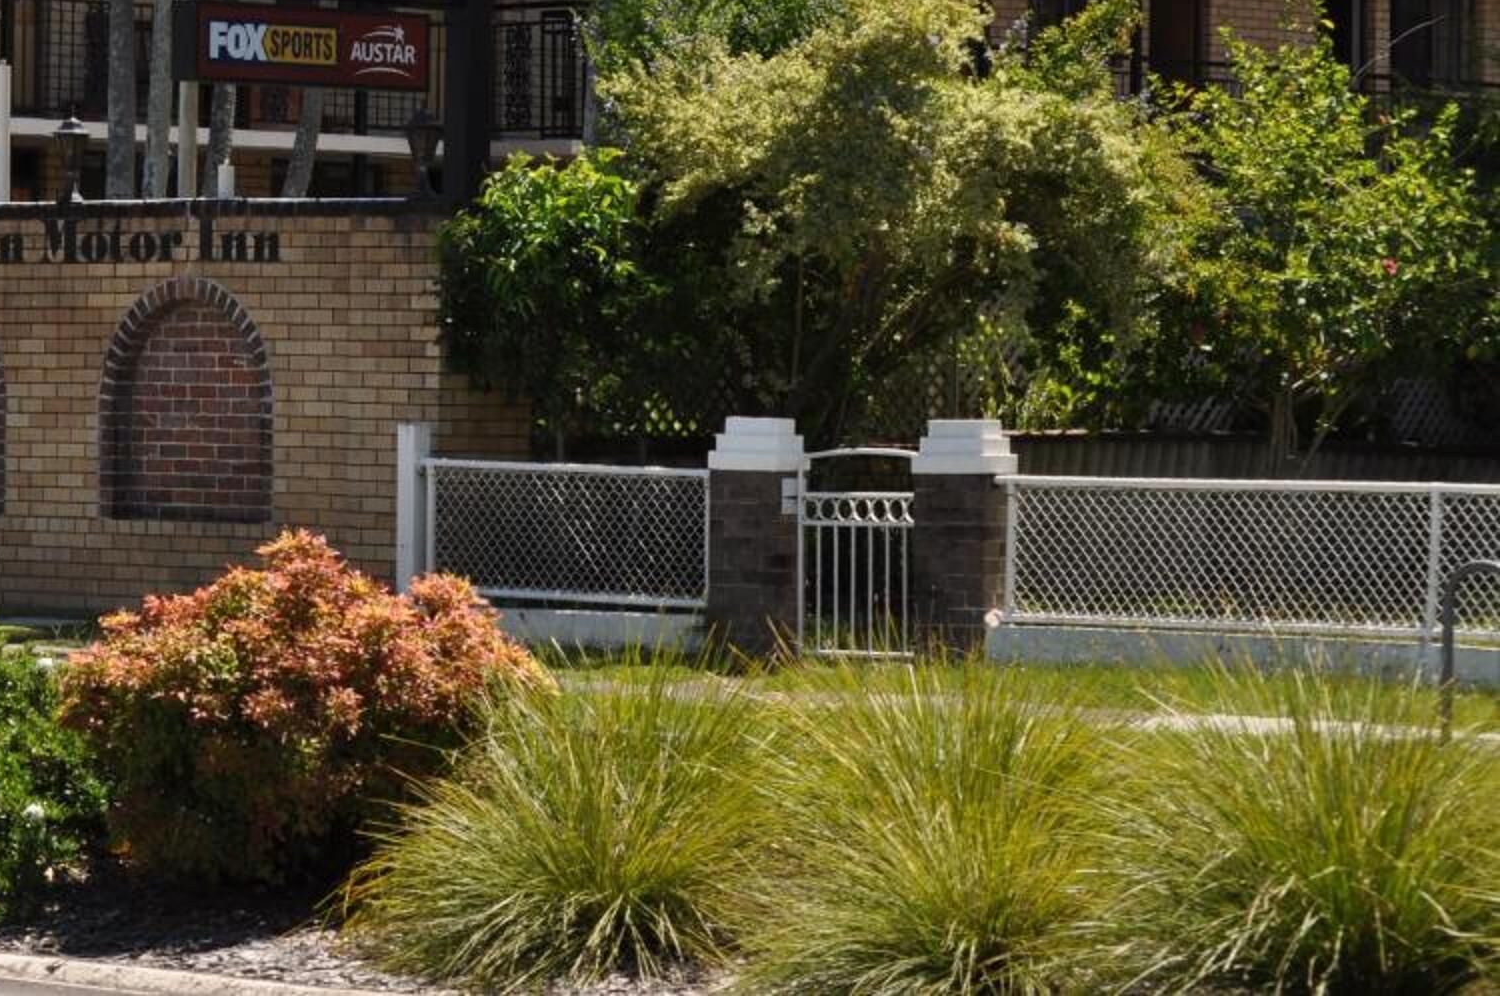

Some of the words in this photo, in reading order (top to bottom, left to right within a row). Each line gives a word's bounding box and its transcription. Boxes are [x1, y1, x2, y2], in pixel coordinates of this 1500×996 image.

[209, 21, 267, 61] FOX
[269, 28, 333, 62] SPORTS
[351, 43, 415, 64] AUSTAR
[45, 219, 183, 264] Motor
[201, 219, 280, 264] Inn
